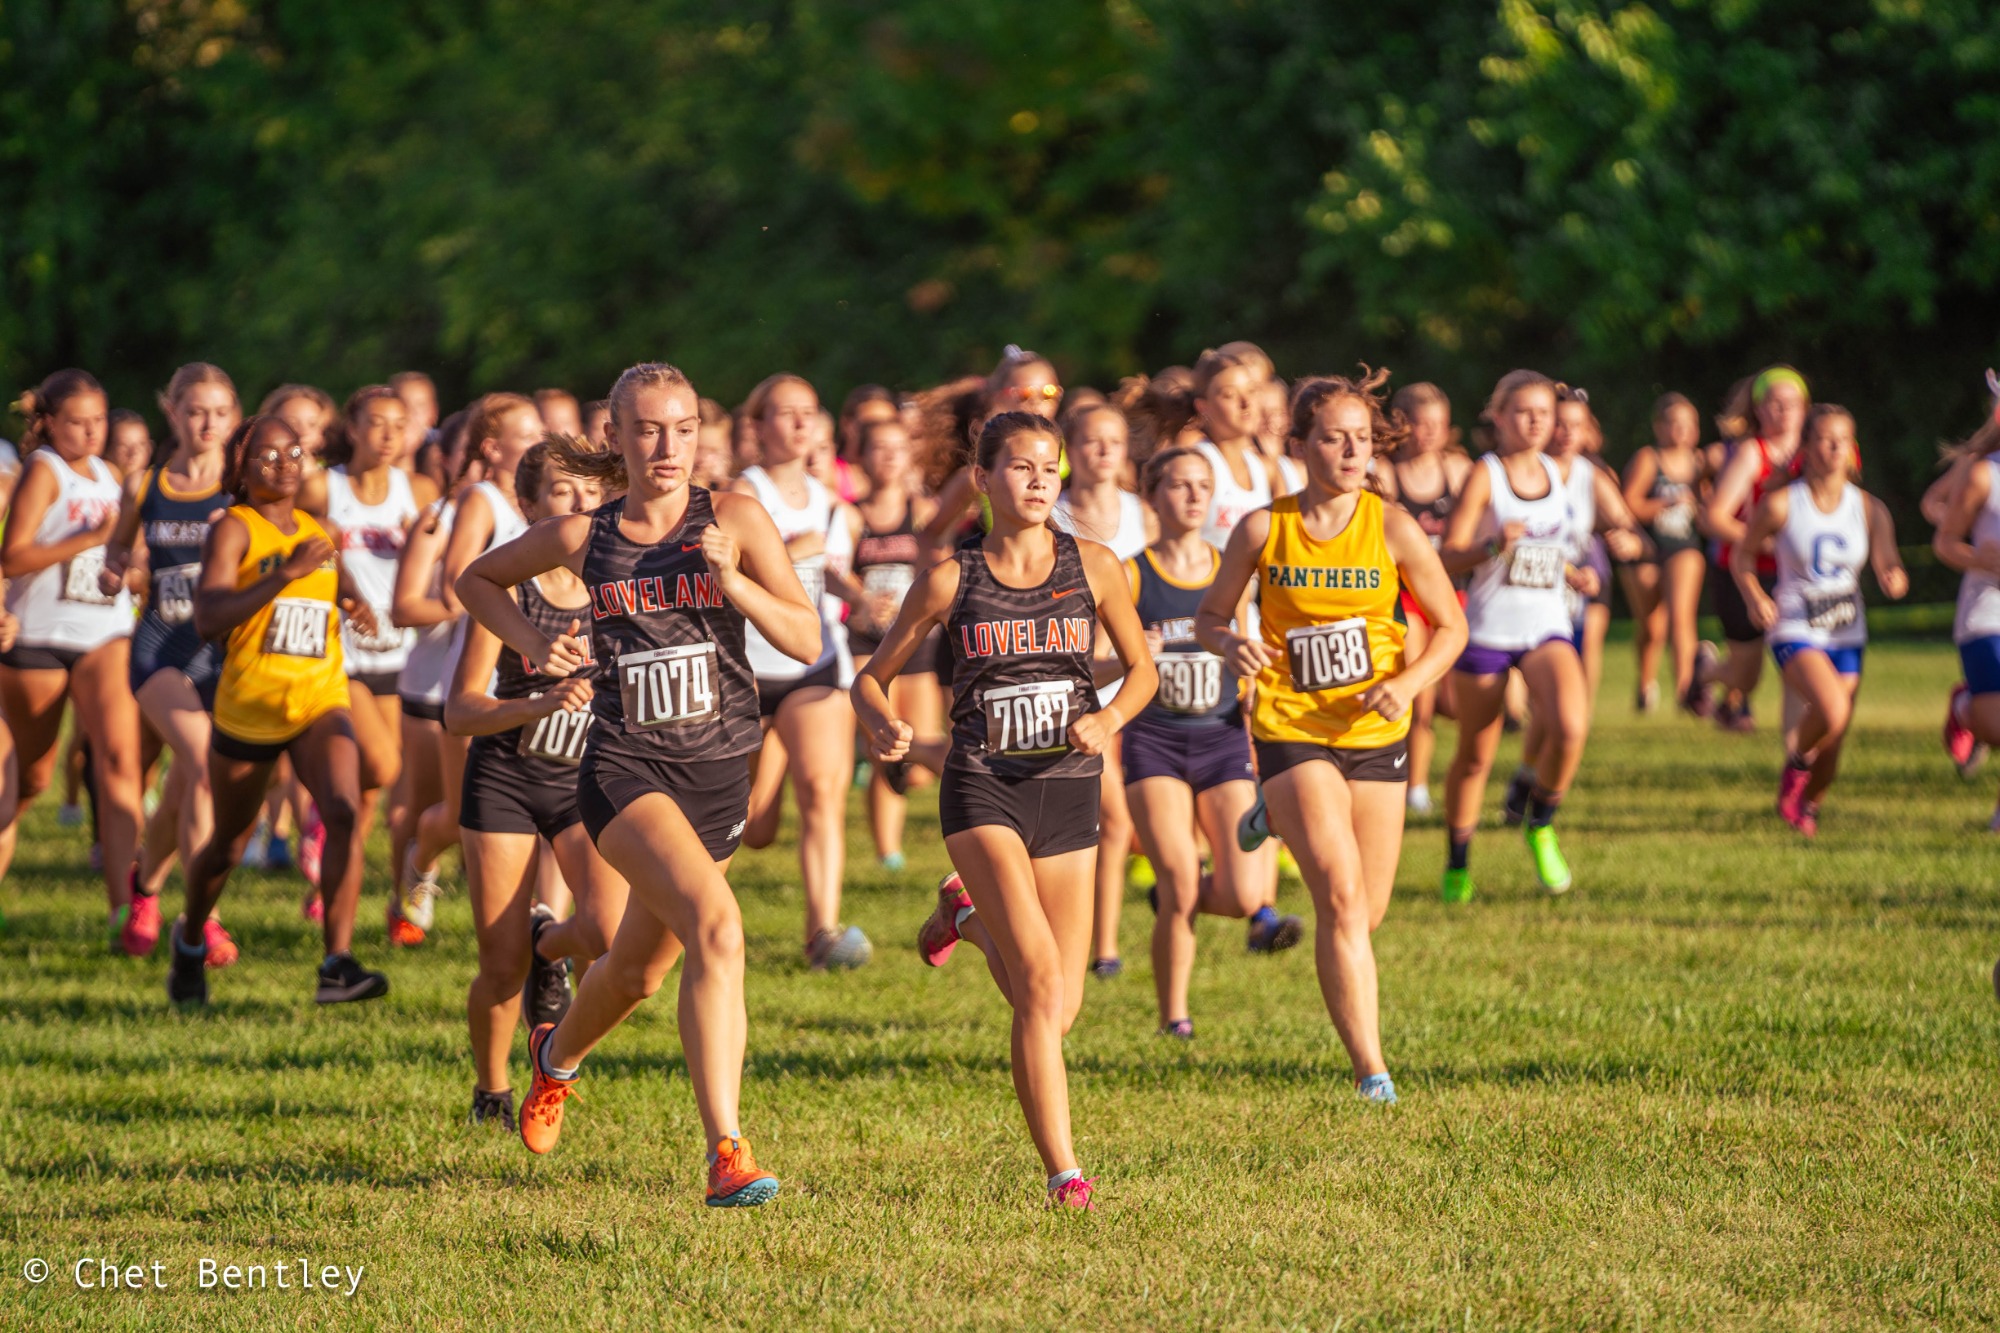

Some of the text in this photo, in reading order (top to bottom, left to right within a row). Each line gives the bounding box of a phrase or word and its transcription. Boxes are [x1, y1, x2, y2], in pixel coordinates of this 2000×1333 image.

[1267, 564, 1381, 590] PANTHERS
[961, 617, 1090, 659] LOVELAND
[1292, 628, 1369, 686] 7038
[626, 655, 714, 723] 7074
[1158, 659, 1222, 709] 6918
[992, 692, 1070, 751] 7087
